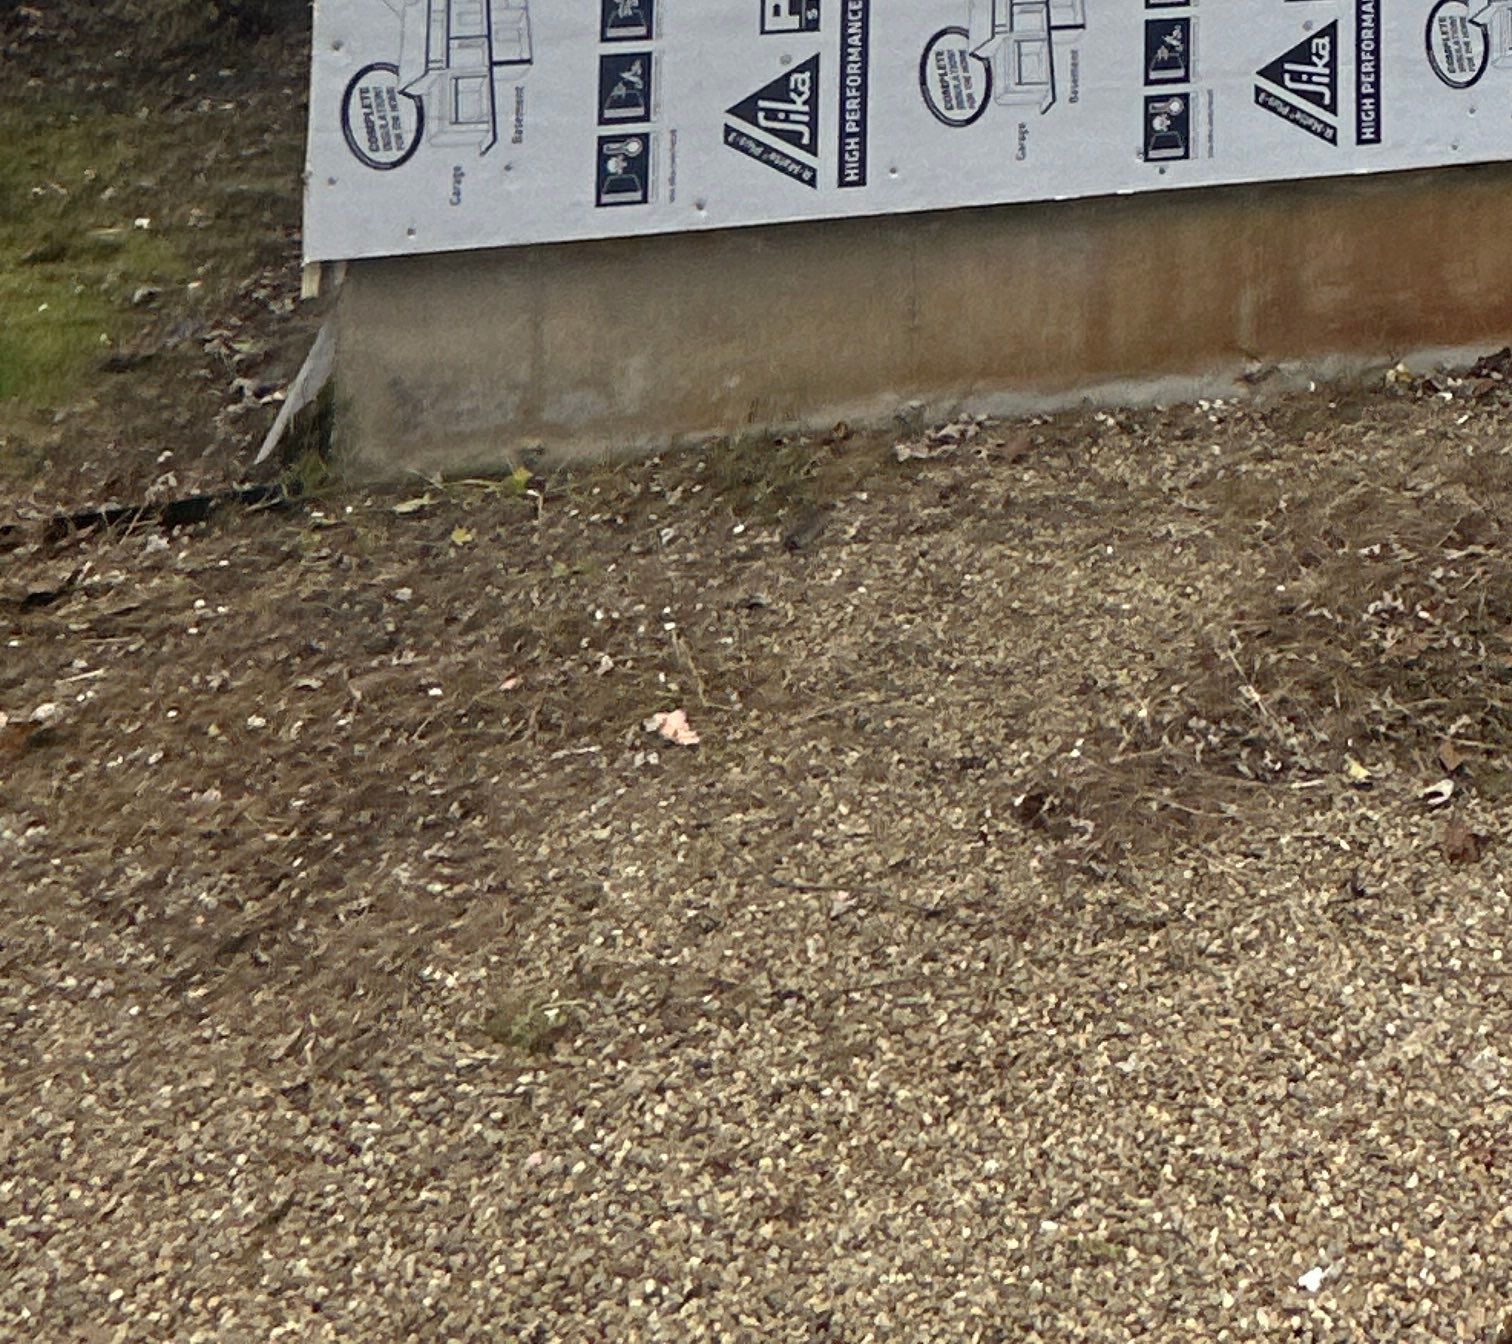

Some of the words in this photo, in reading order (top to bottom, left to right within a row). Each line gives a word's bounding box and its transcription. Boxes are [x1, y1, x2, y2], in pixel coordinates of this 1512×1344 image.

[844, 0, 864, 136] PERFORMANCE
[1284, 34, 1331, 106] Sika
[757, 70, 811, 145] Sika
[1359, 103, 1376, 140] HIGH
[843, 141, 861, 182] HIGH
